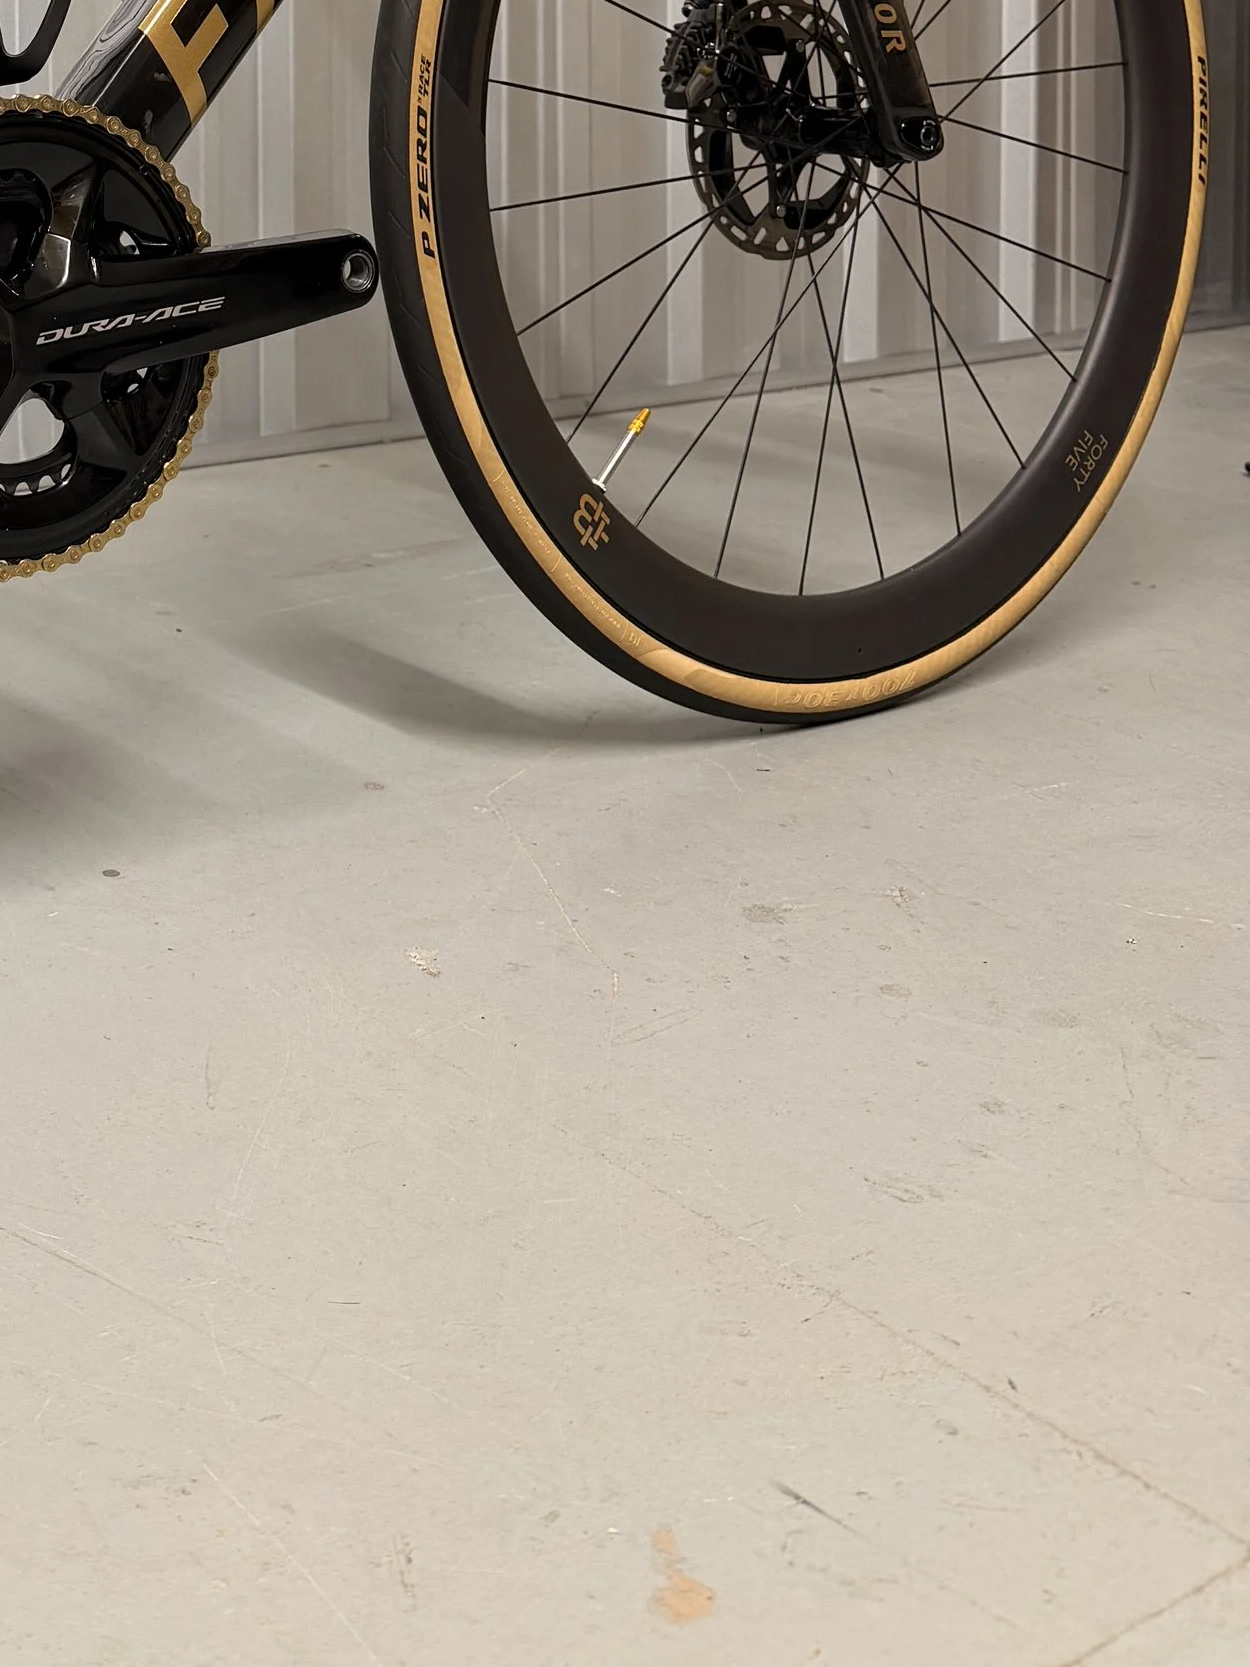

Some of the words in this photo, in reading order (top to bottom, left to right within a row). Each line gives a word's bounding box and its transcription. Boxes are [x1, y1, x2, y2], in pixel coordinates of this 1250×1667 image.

[418, 53, 427, 95] RACE
[422, 58, 432, 98] TLR
[1197, 55, 1208, 186] PIRELLI
[421, 230, 436, 259] P
[36, 296, 226, 346] DURA-ACE
[1065, 429, 1094, 471] FIVE
[1073, 434, 1109, 493] FORTY
